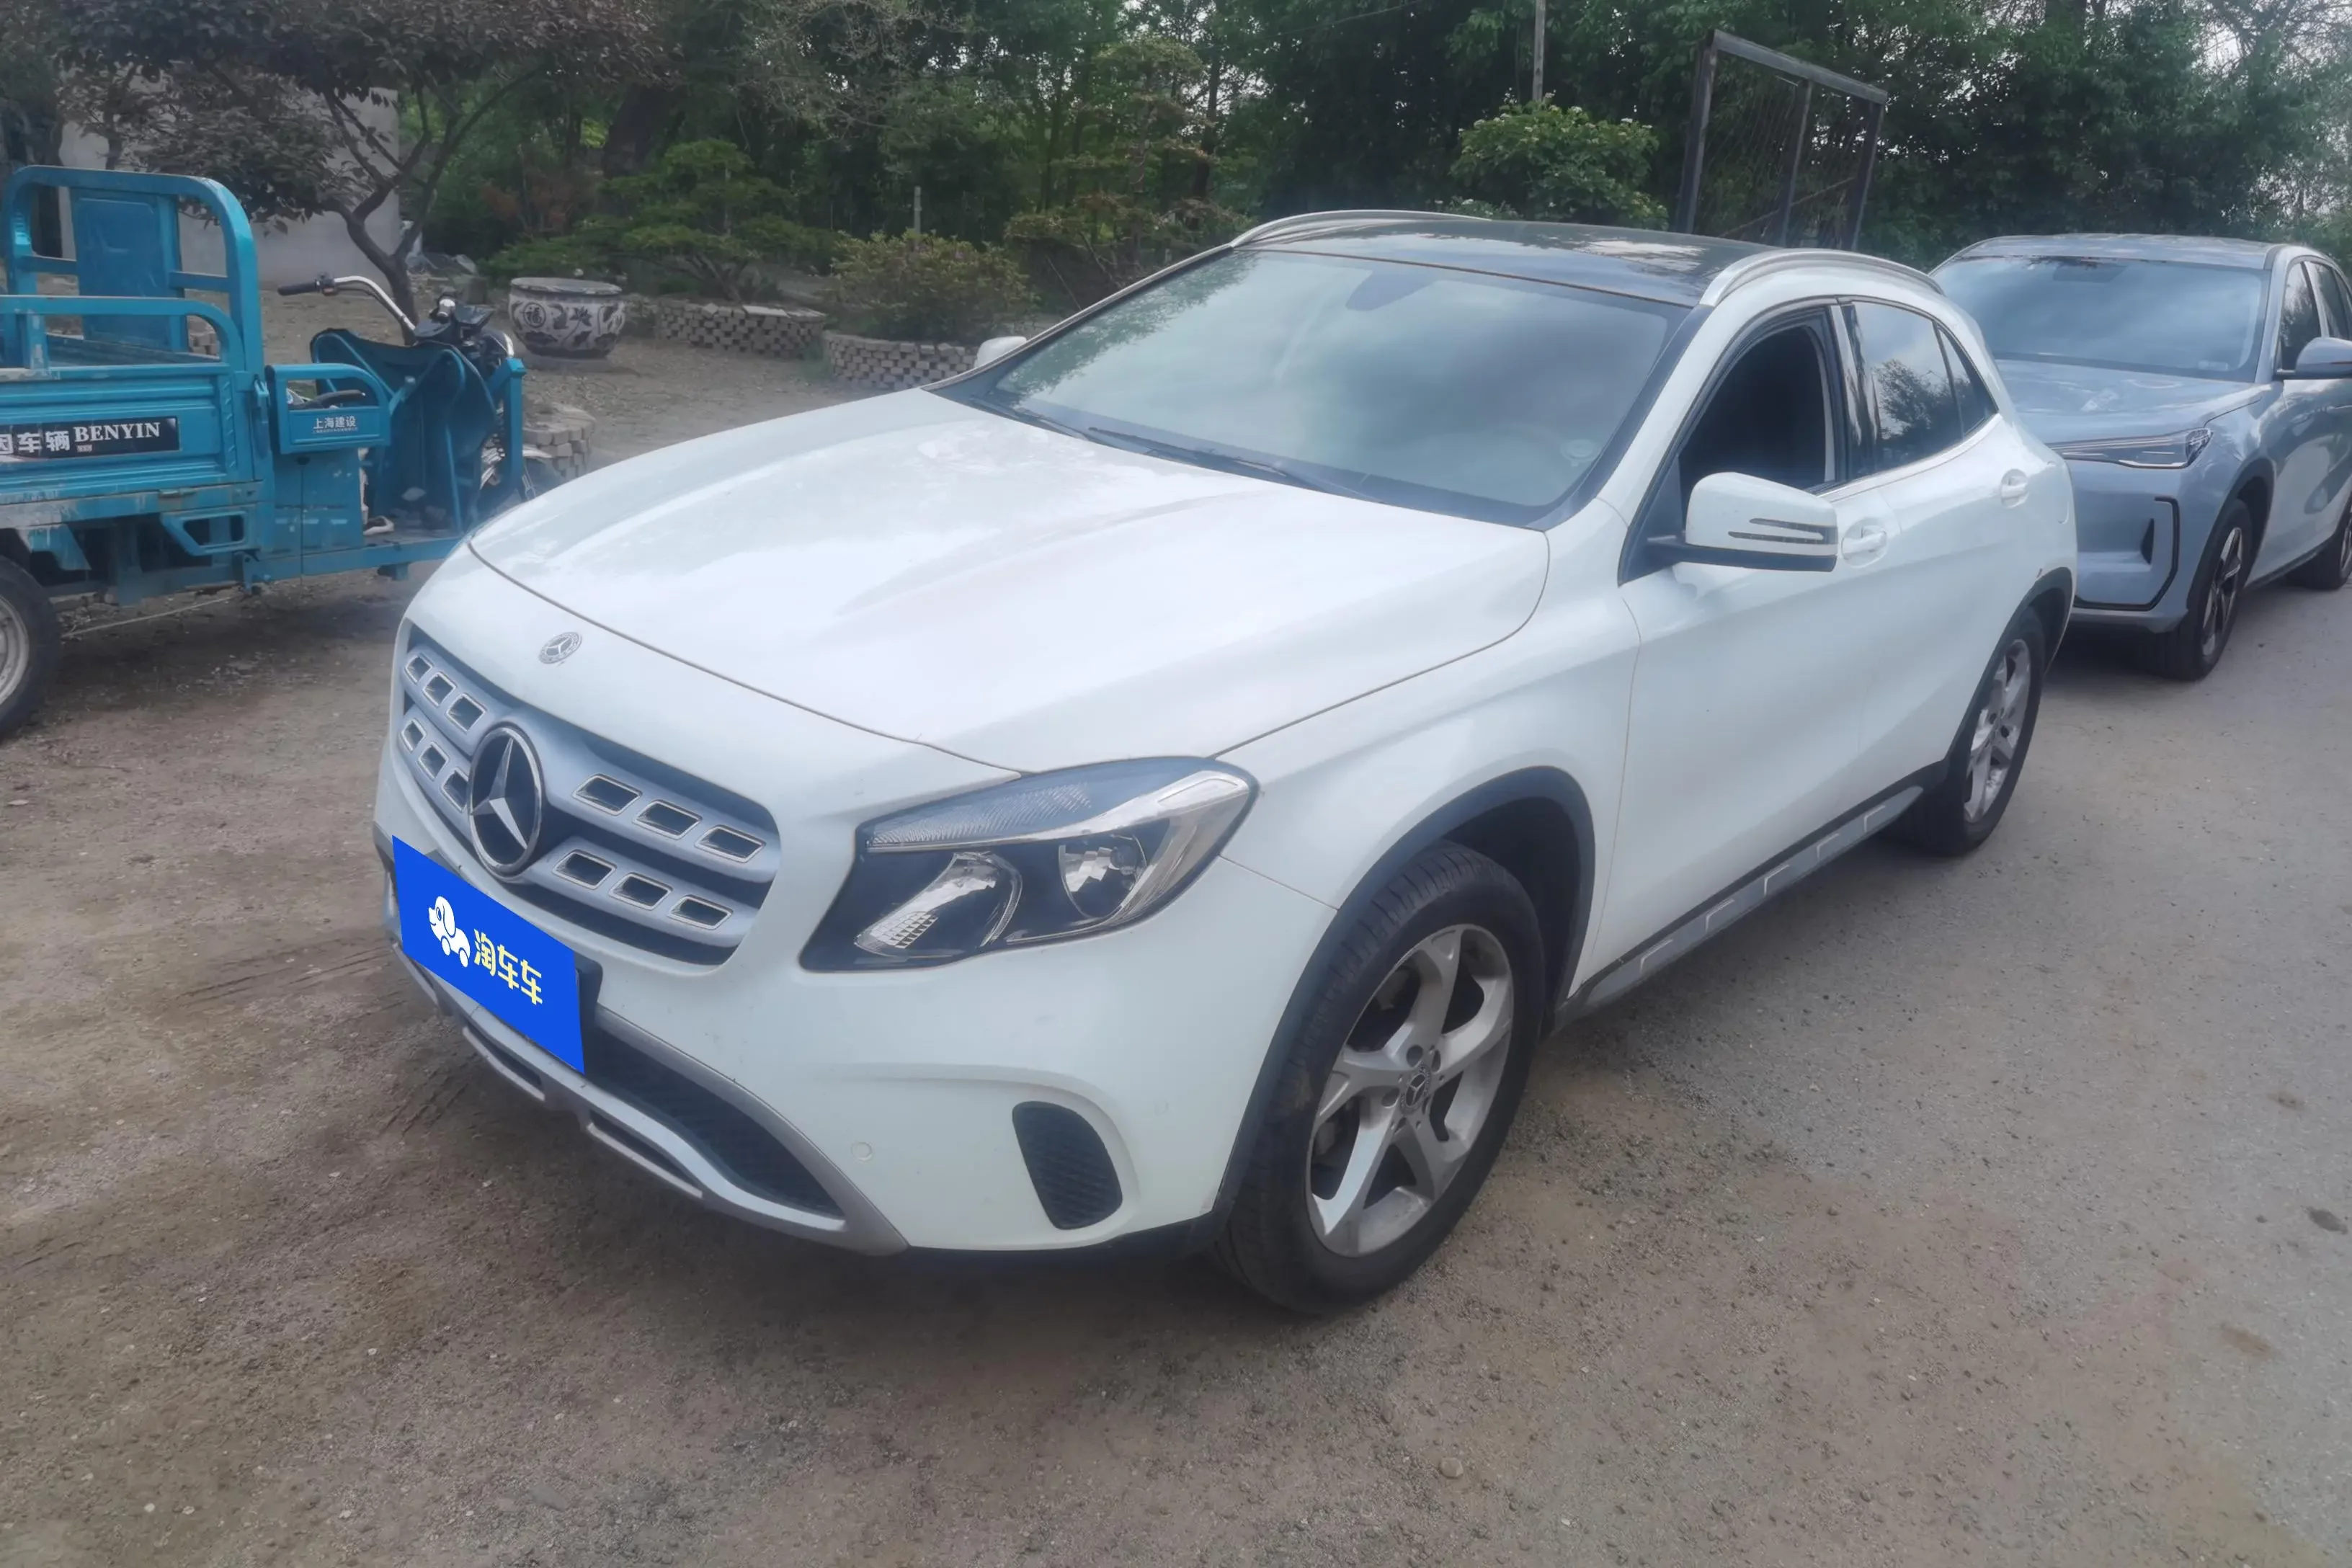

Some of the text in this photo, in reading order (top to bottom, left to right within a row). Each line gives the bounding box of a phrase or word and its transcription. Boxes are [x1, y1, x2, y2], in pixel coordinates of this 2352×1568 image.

[313, 416, 356, 429] 上海建设
[73, 422, 160, 442] BENYIN
